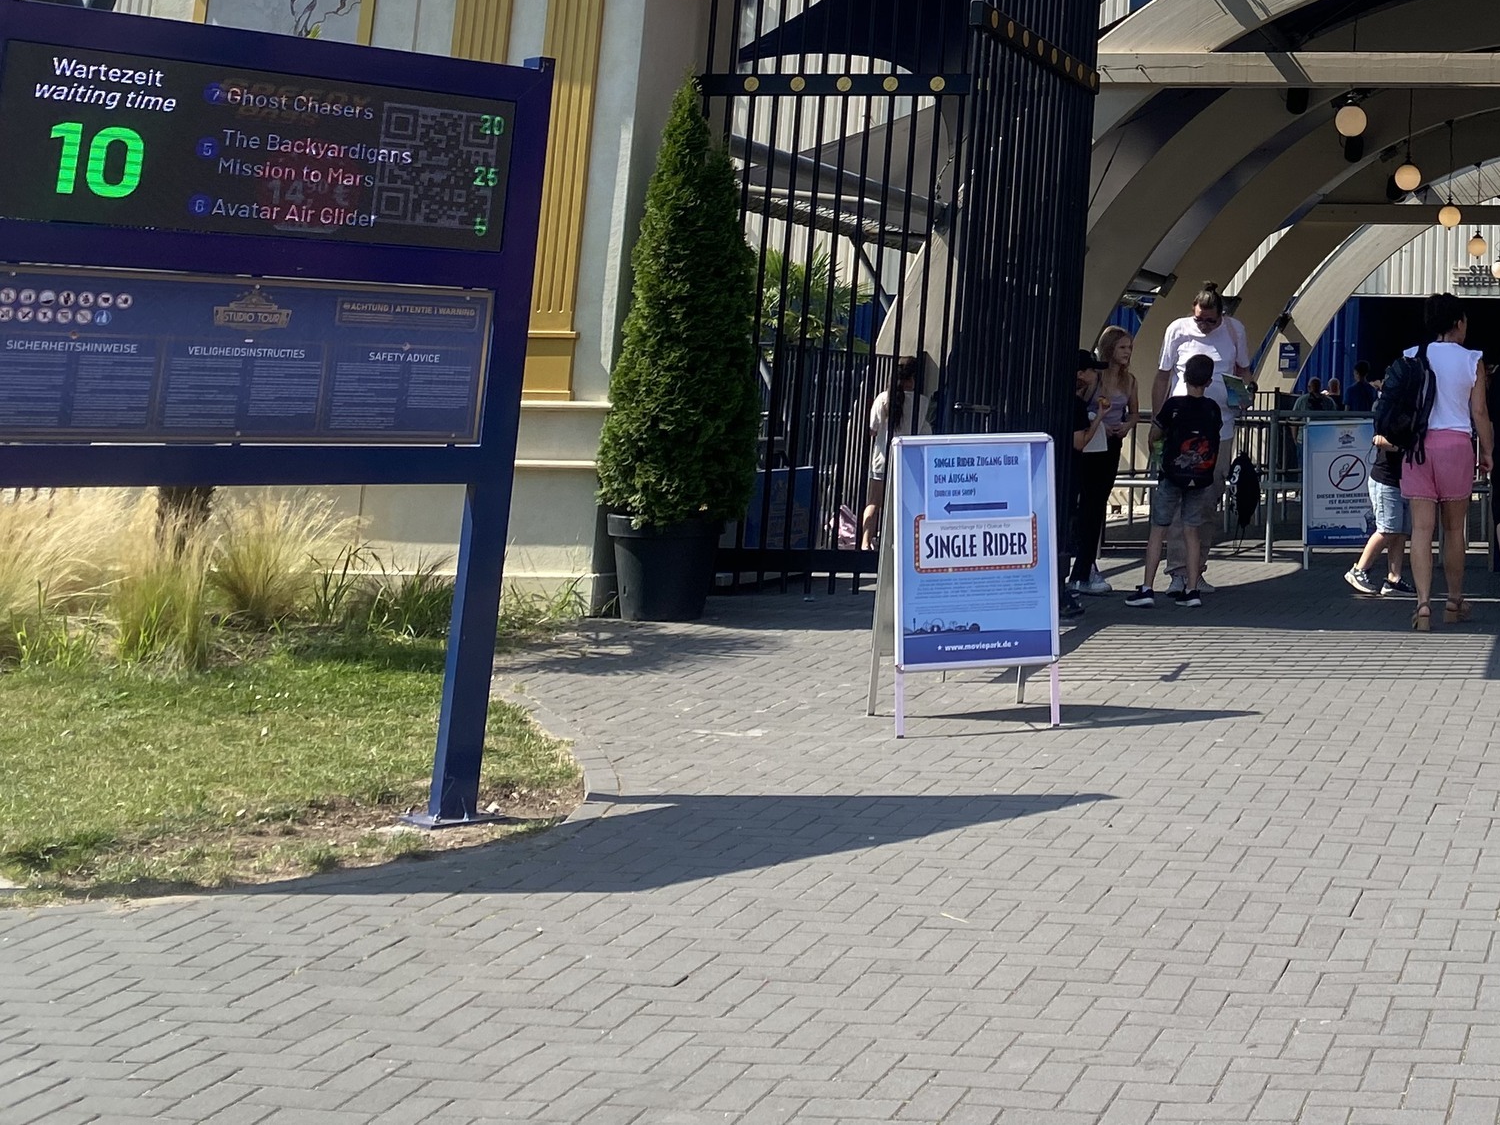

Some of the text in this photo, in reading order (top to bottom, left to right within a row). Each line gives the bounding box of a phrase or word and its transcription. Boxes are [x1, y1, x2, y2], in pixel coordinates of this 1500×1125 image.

[53, 56, 165, 88] Wartezeit
[34, 82, 177, 113] waiting time
[226, 87, 288, 111] Ghost
[293, 95, 375, 121] Chasers
[478, 114, 505, 136] 20
[202, 143, 213, 156] 5
[223, 128, 413, 165] The Backyardigans
[50, 121, 145, 199] 10
[218, 157, 499, 188] Mission to Mars 25
[211, 198, 281, 221] Avatar
[284, 204, 316, 223] Air
[319, 207, 378, 228] Glider
[223, 312, 280, 323] STUDIO TOUR
[6, 339, 139, 355] SICHERHEITSHINWEISE
[188, 346, 306, 359] VEILIGHEIDSINSTRUCTIES
[368, 352, 441, 364] SAFETY ADVICE
[934, 457, 955, 469] SINGLE
[956, 456, 975, 468] RIDER
[976, 455, 1003, 467] ZUGANG
[934, 472, 979, 484] DEN AUSGANG
[925, 531, 1028, 559] SINGLE RIDER
[944, 639, 1012, 652] www.moviepark.de
